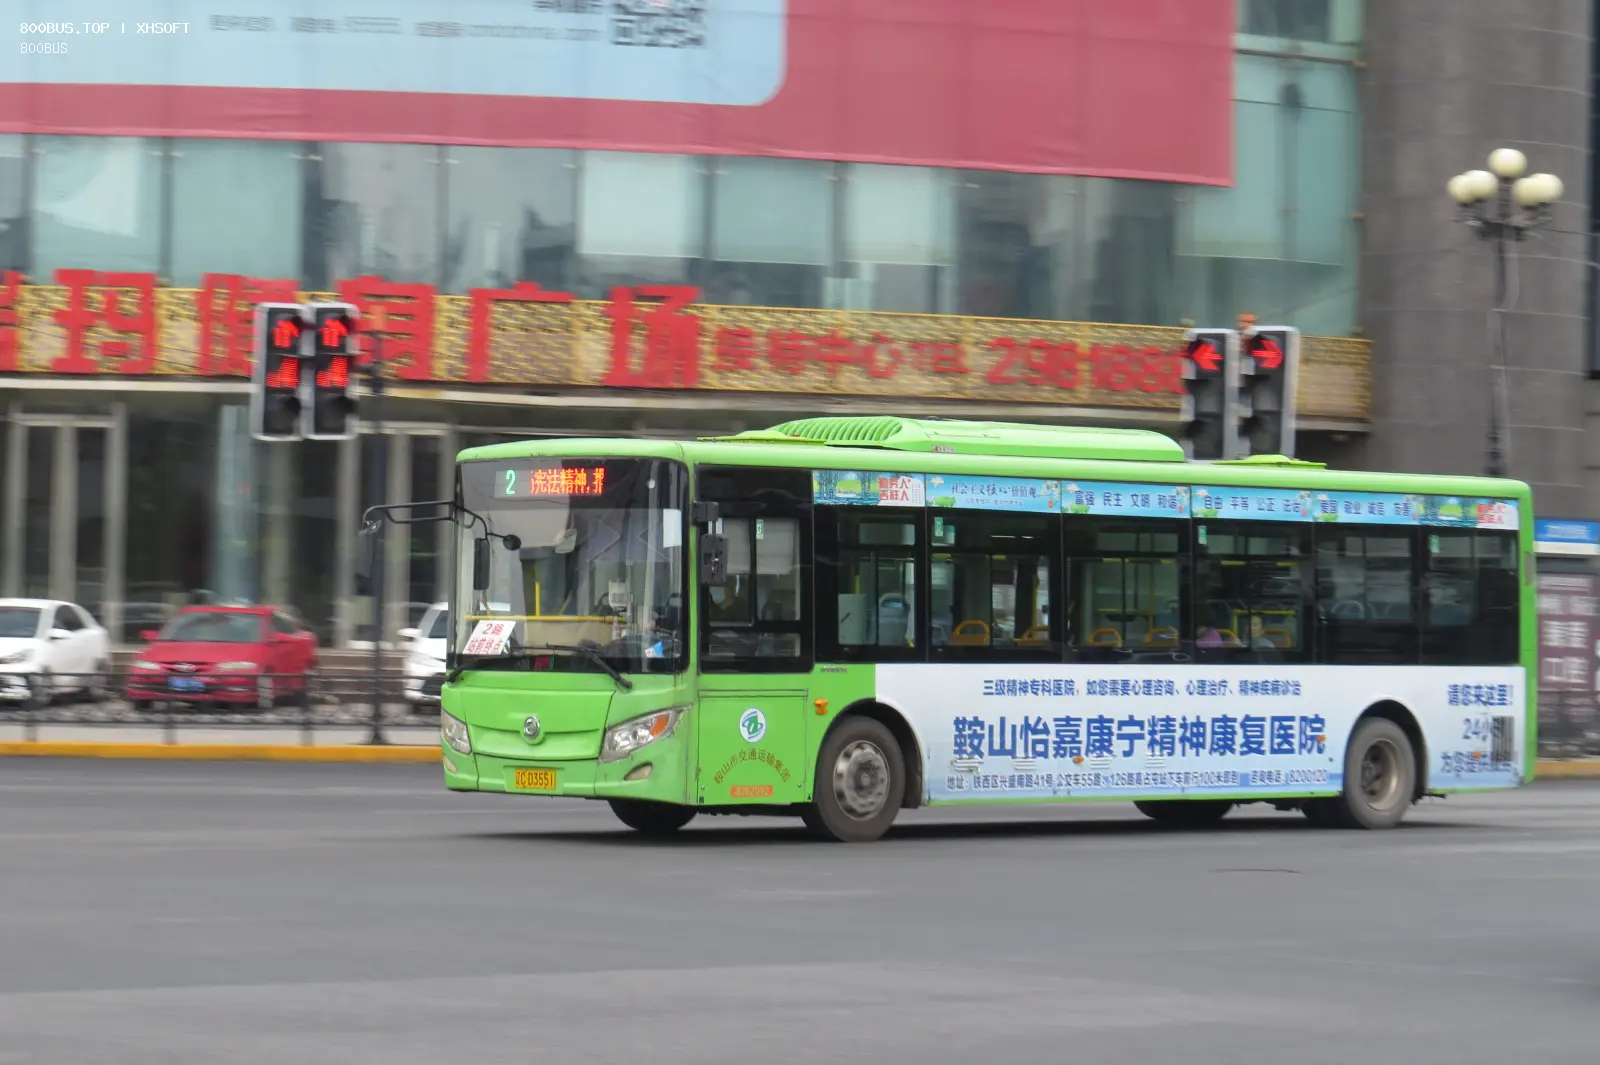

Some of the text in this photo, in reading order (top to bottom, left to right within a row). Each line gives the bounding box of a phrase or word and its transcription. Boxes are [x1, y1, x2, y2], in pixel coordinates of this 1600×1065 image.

[506, 469, 516, 495] 2
[1103, 491, 1123, 507] 民主
[1130, 493, 1150, 508] 文明
[953, 714, 1327, 760] 鞍山怡嘉康宁精神康复医院
